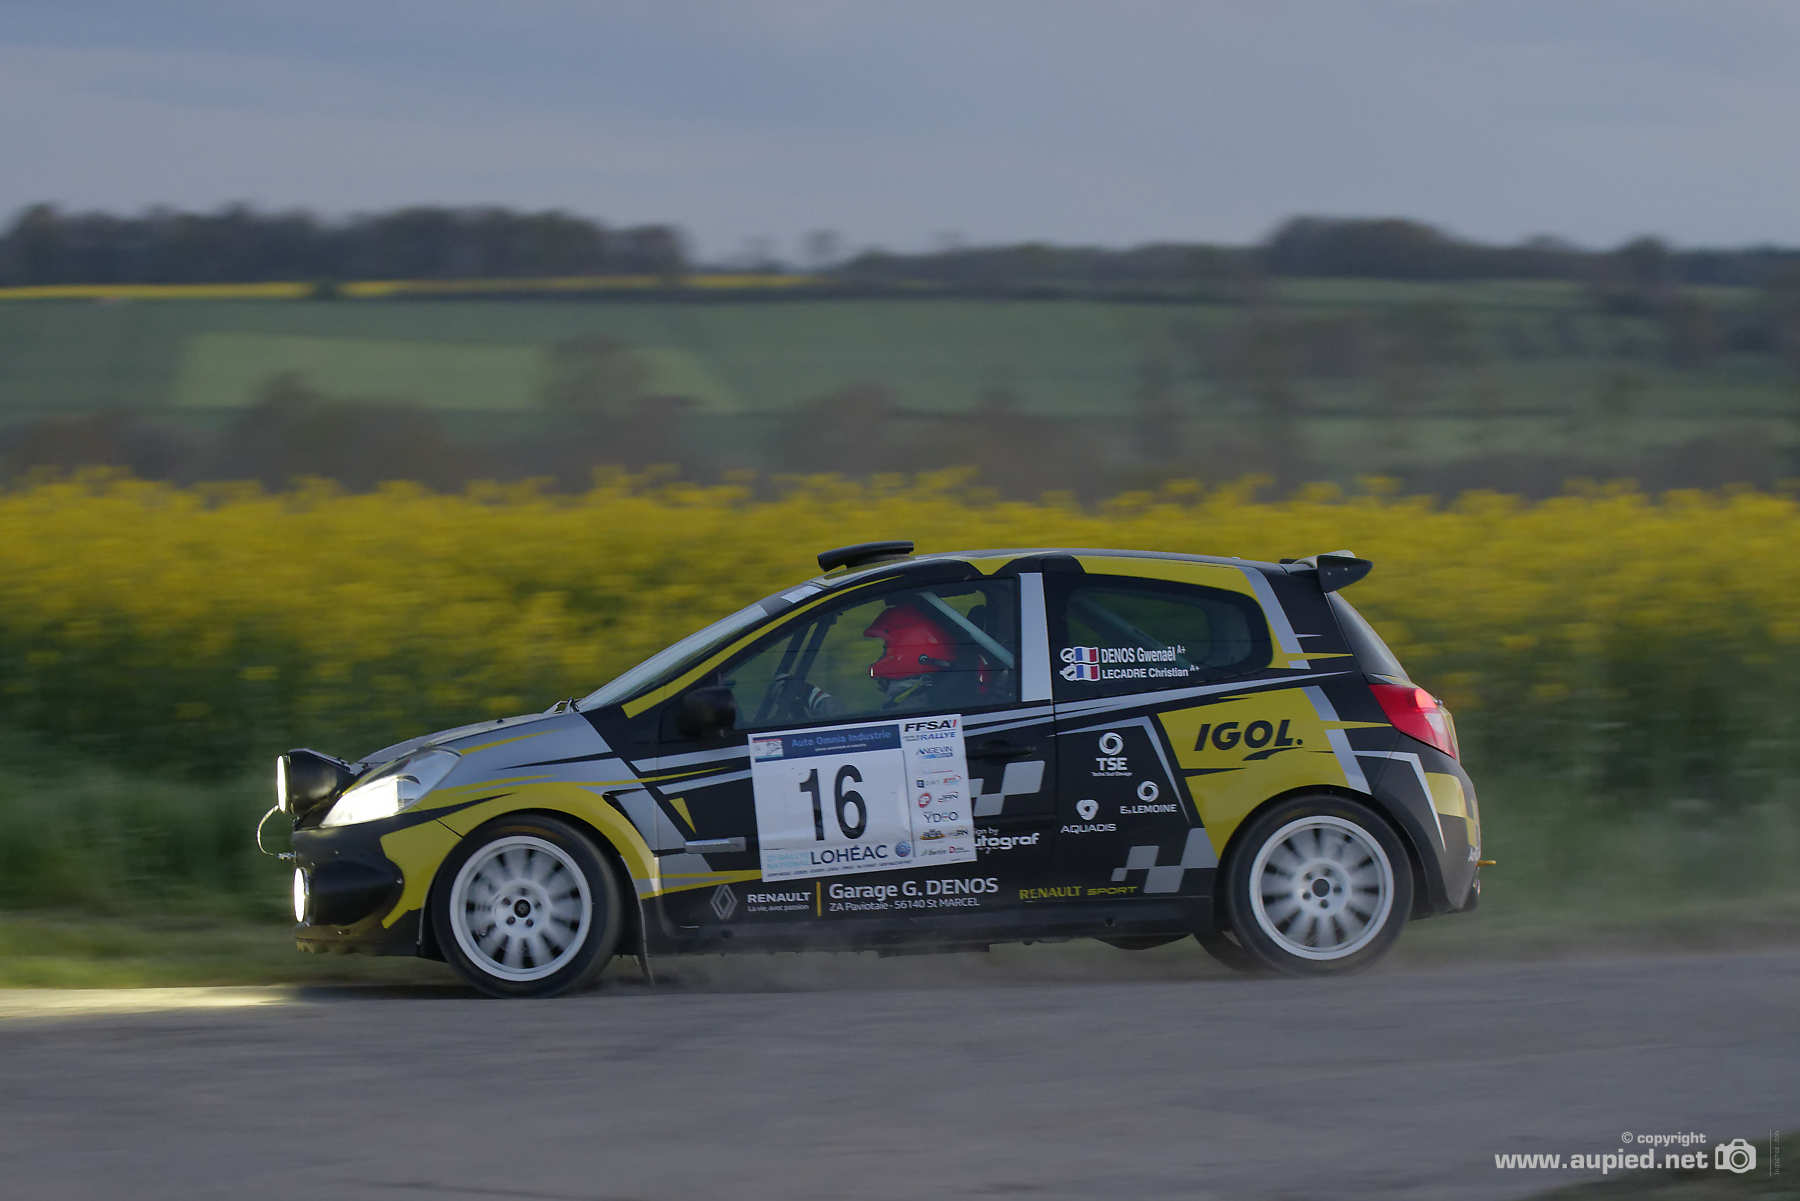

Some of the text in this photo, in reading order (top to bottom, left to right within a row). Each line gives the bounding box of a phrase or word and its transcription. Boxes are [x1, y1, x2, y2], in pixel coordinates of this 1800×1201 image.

[1101, 647, 1135, 664] DENOS
[1136, 646, 1177, 662] Gwenaël
[1102, 668, 1147, 680] LECADRE
[1148, 667, 1189, 679] Christian
[904, 719, 952, 733] FFSA
[1095, 757, 1128, 771] TSE
[799, 764, 867, 841] 16
[1060, 823, 1117, 834] AQUADIS
[974, 832, 1040, 850] utograf
[810, 844, 888, 865] LOHÉAC
[829, 877, 999, 902] Garage G. DENOS
[1019, 886, 1138, 900] RENAULT SPORT
[747, 891, 812, 903] RENAULT
[829, 902, 844, 912] ZA
[939, 897, 981, 907] MARCEL
